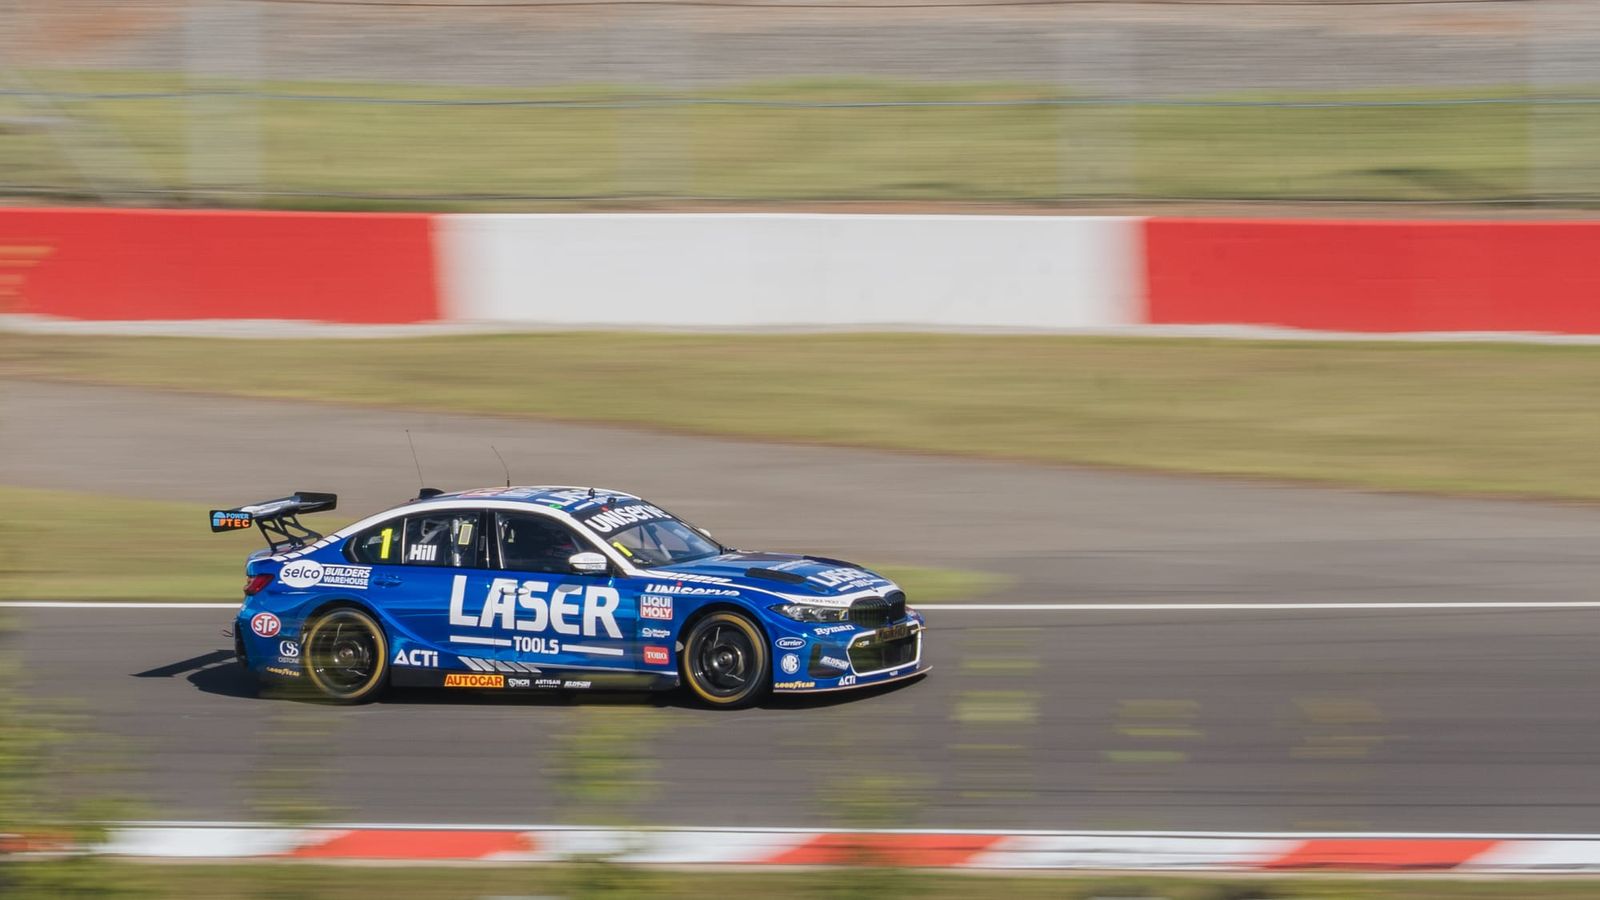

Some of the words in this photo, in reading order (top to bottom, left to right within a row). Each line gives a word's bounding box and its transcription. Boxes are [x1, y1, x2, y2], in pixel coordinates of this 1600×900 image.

[227, 519, 249, 527] TEC
[380, 528, 393, 559] 1
[612, 541, 633, 557] 1
[409, 544, 437, 561] Hill
[283, 566, 320, 579] selco
[325, 567, 371, 578] BUILDERS
[323, 576, 368, 586] WAREHOUSE
[449, 575, 624, 639] LASER
[643, 596, 671, 607] LIQUI
[642, 606, 672, 618] MOLY
[255, 616, 277, 634] STP
[813, 624, 855, 636] Ryman
[513, 636, 559, 655] TOOLS
[446, 675, 502, 687] AUTOCAR
[774, 681, 816, 689] GOODYEAR
